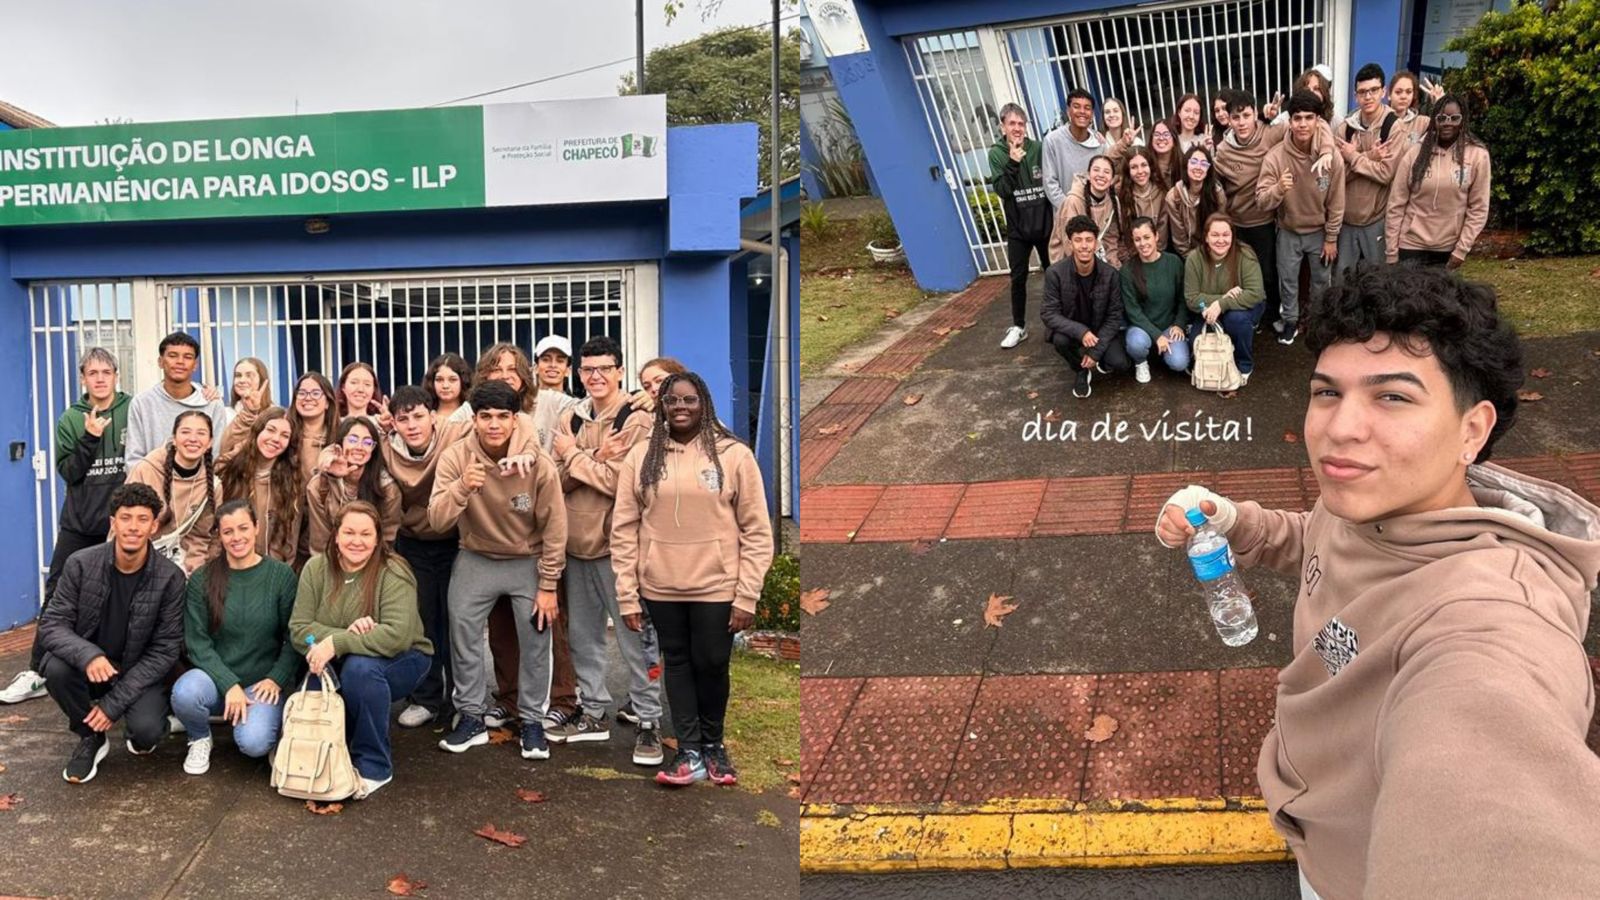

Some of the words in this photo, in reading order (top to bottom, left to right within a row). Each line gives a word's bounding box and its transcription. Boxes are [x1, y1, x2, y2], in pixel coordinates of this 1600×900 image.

[0, 137, 167, 172] INSTITUIÇÃO
[172, 139, 210, 163] DE
[214, 134, 316, 161] LONGA
[563, 138, 607, 146] PREFEITURA
[608, 136, 618, 144] DE
[563, 144, 618, 160] CHAPECÓ
[0, 175, 199, 208] PERMANÊNCIA
[203, 173, 277, 199] PARA
[281, 167, 389, 195] IDOSOS
[412, 164, 457, 189] ILP
